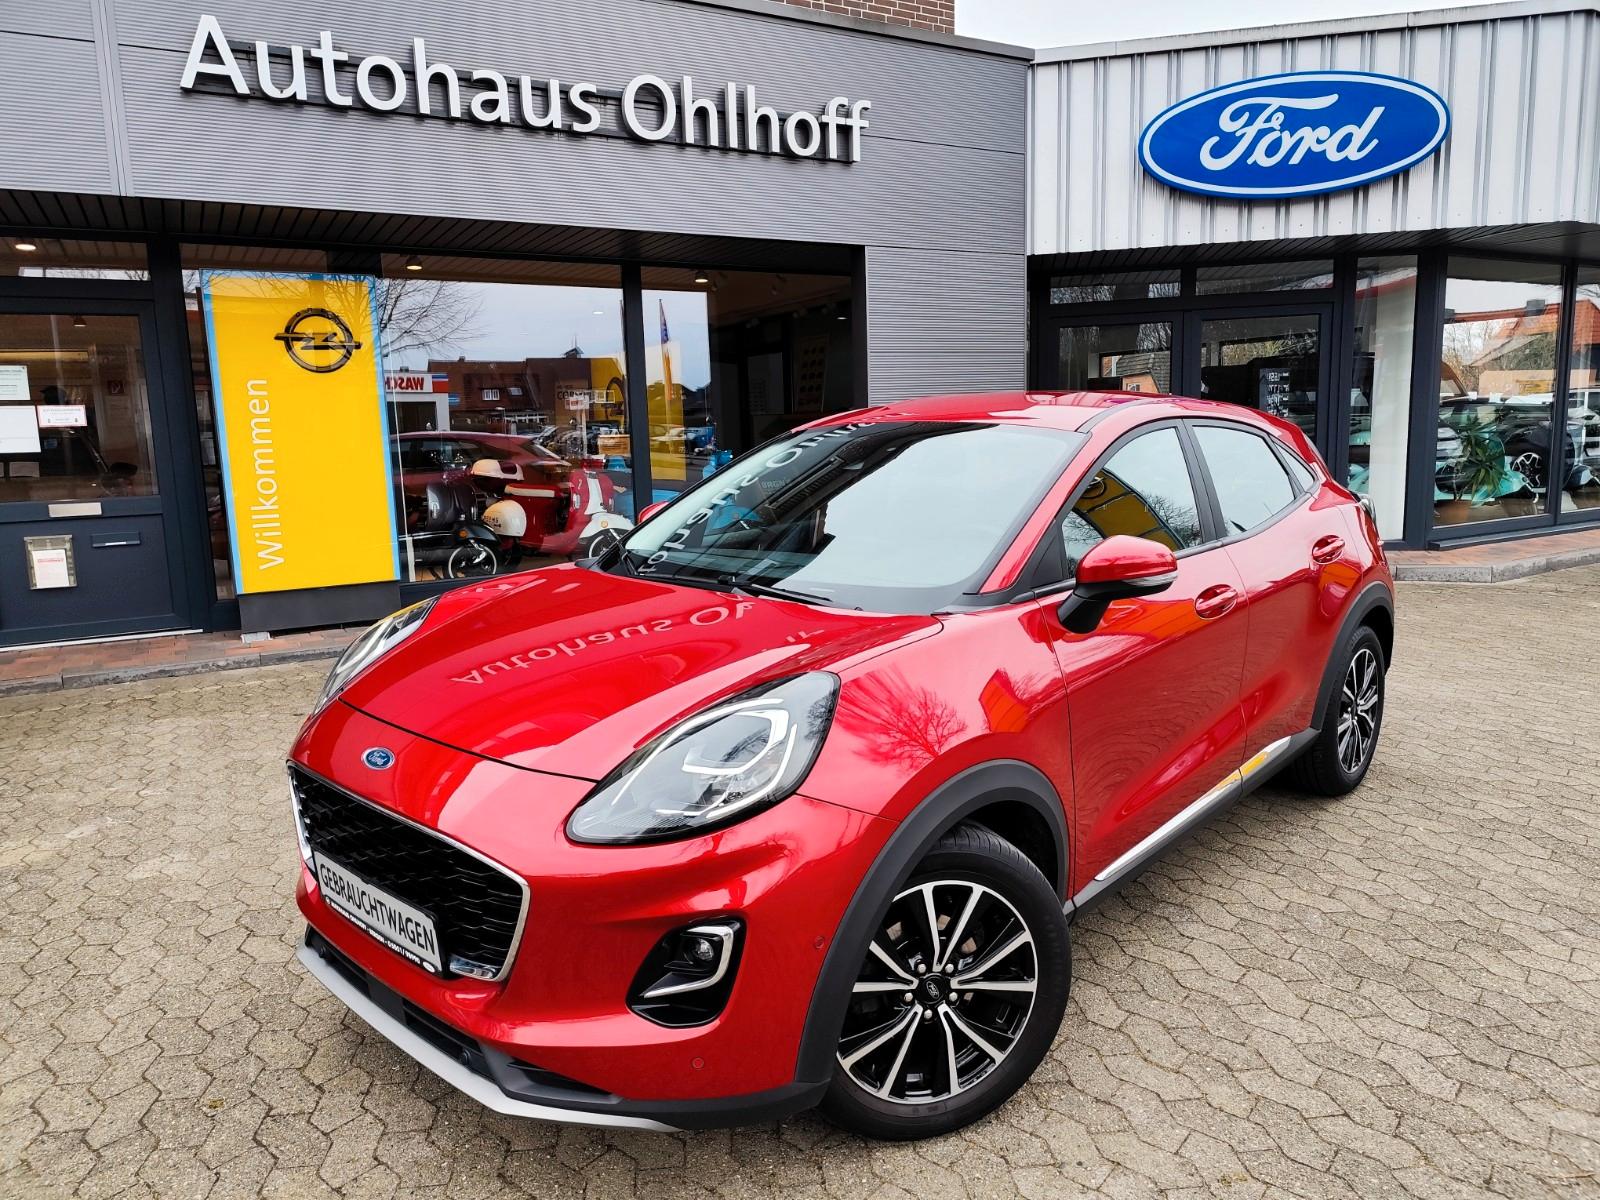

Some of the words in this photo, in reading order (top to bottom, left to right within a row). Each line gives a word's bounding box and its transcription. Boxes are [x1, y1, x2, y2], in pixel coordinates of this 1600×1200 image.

[180, 14, 601, 133] Autohaus
[622, 74, 872, 163] Ohlhoff
[1199, 93, 1386, 171] Ford
[246, 378, 285, 570] Willkommen
[319, 863, 436, 956] GEBRAUCHTWAGEN
